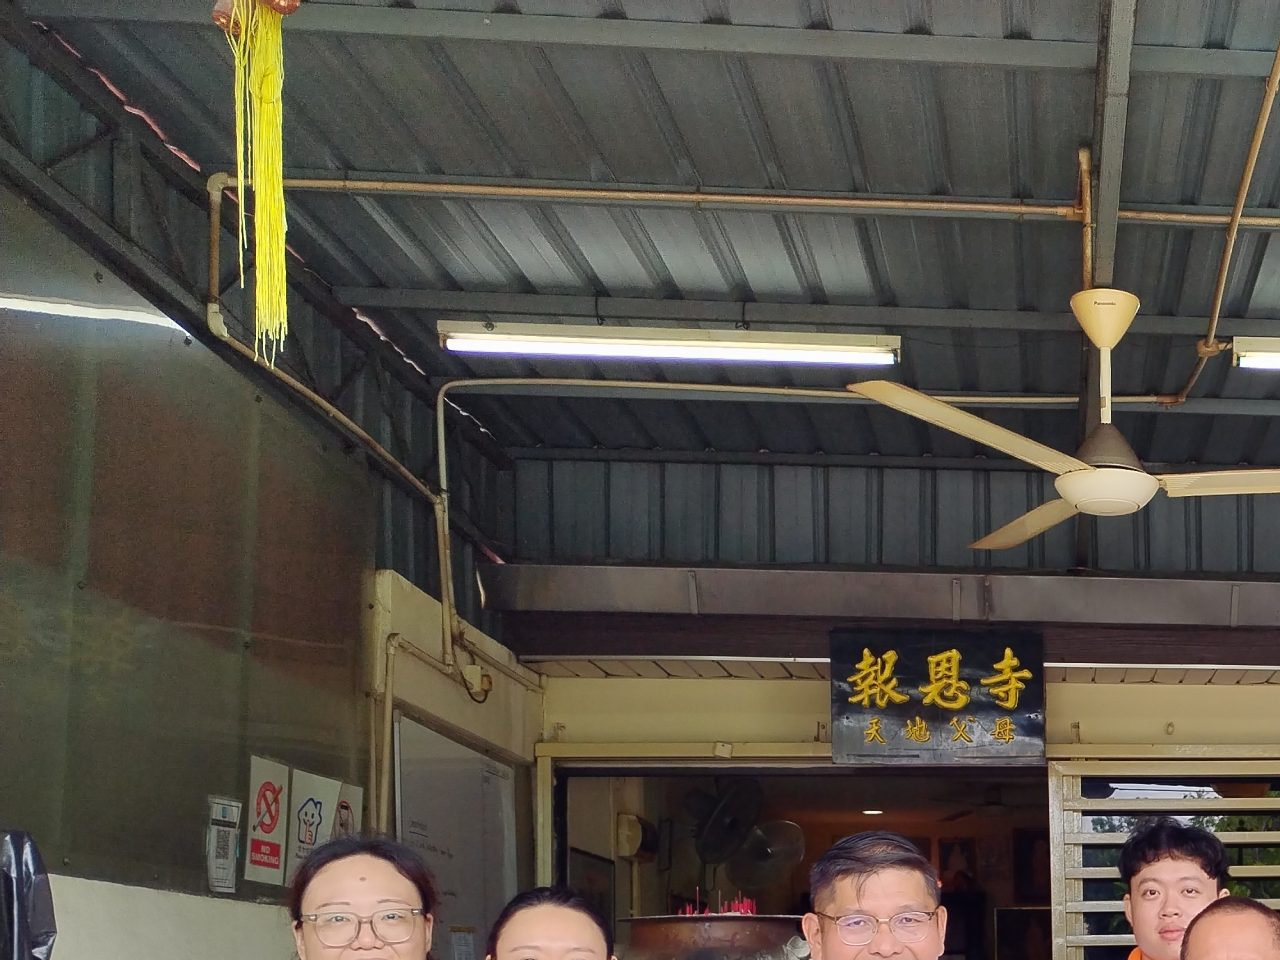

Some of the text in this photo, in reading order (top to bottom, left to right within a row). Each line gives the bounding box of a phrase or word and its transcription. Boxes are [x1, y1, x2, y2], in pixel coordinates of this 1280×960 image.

[847, 647, 1032, 709] 報恩寺
[864, 716, 1016, 745] 天地父母
[251, 852, 279, 865] SMOKING
[260, 845, 271, 854] NO
